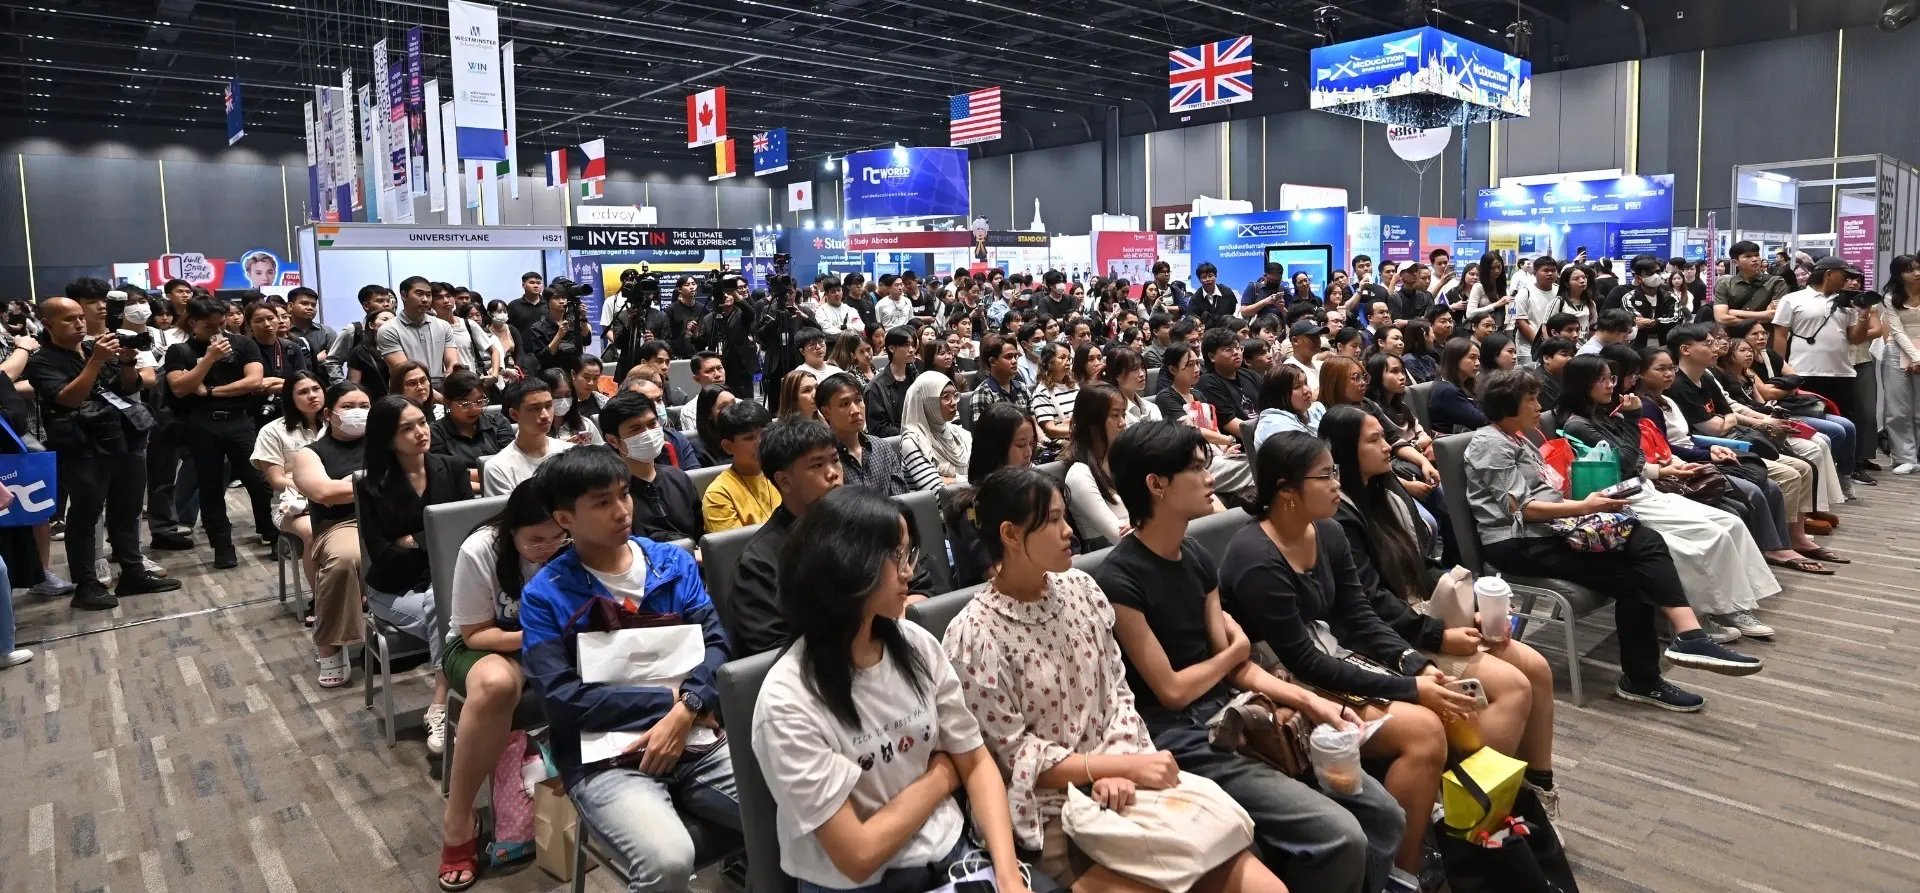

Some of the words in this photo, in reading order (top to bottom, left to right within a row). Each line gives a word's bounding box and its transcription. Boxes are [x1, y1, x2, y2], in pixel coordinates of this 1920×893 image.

[454, 35, 497, 46] WESTMINSTER
[468, 61, 487, 72] WIN
[1473, 62, 1508, 84] McDUCATION
[1188, 101, 1206, 109] UNITED
[1206, 98, 1232, 107] KINGDOM
[880, 167, 910, 179] WORLD
[592, 208, 636, 222] edvoy
[409, 233, 489, 242] UNIVERSITYLANE
[542, 234, 562, 242] HS21
[673, 231, 687, 239] THE
[853, 237, 869, 246] Study
[871, 236, 898, 244] Abroad
[183, 255, 202, 264] Wall
[185, 264, 207, 272] Street
[184, 272, 210, 282] English
[853, 733, 873, 747] PICK
[894, 716, 912, 730] BEST
